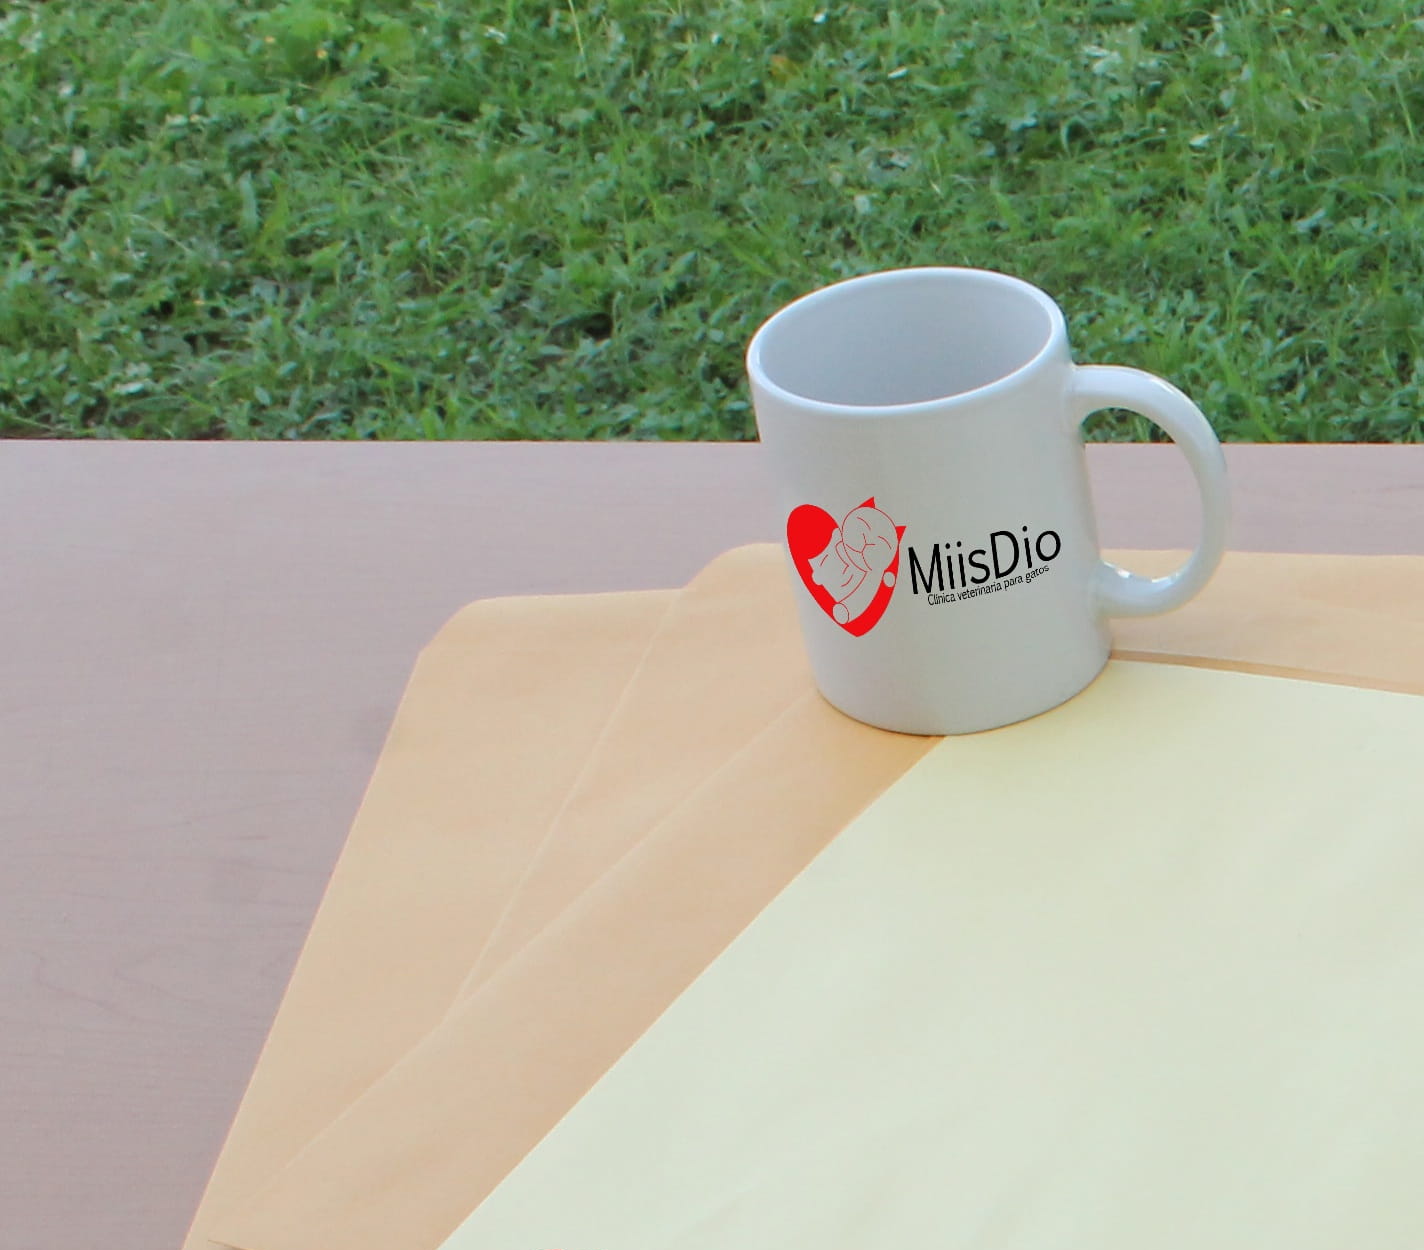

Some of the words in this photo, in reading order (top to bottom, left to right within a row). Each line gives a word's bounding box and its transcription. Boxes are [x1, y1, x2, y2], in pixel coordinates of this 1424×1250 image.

[908, 525, 1061, 595] MiisDio
[957, 581, 1003, 601] veterinaria
[1004, 576, 1023, 591] para
[1025, 564, 1050, 583] gatos
